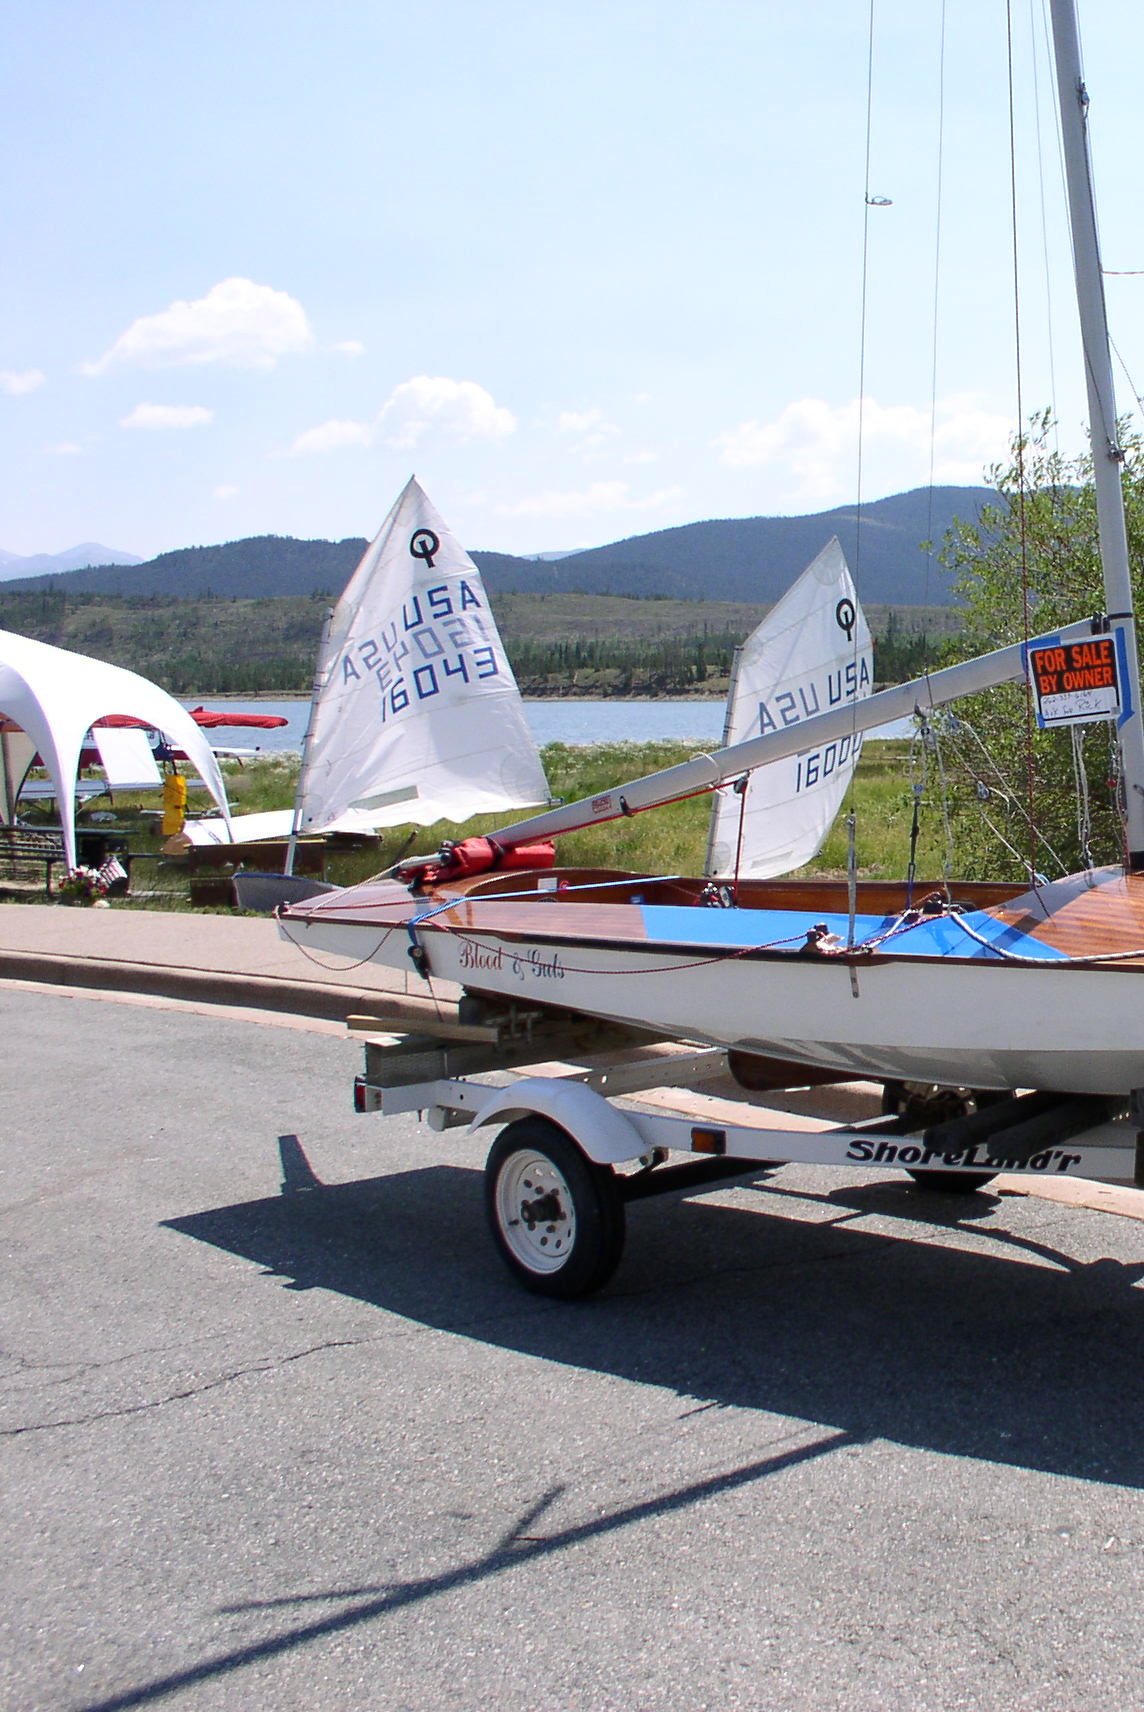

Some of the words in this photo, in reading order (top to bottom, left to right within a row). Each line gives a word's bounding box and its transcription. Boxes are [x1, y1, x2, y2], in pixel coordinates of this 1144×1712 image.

[403, 580, 482, 631] USA
[1035, 649, 1067, 673] FOR
[1071, 641, 1112, 668] SALE
[381, 646, 499, 723] 16043
[828, 657, 870, 705] USA
[1039, 674, 1058, 694] BY
[1063, 666, 1113, 690] OWNER
[458, 941, 503, 971] Blood
